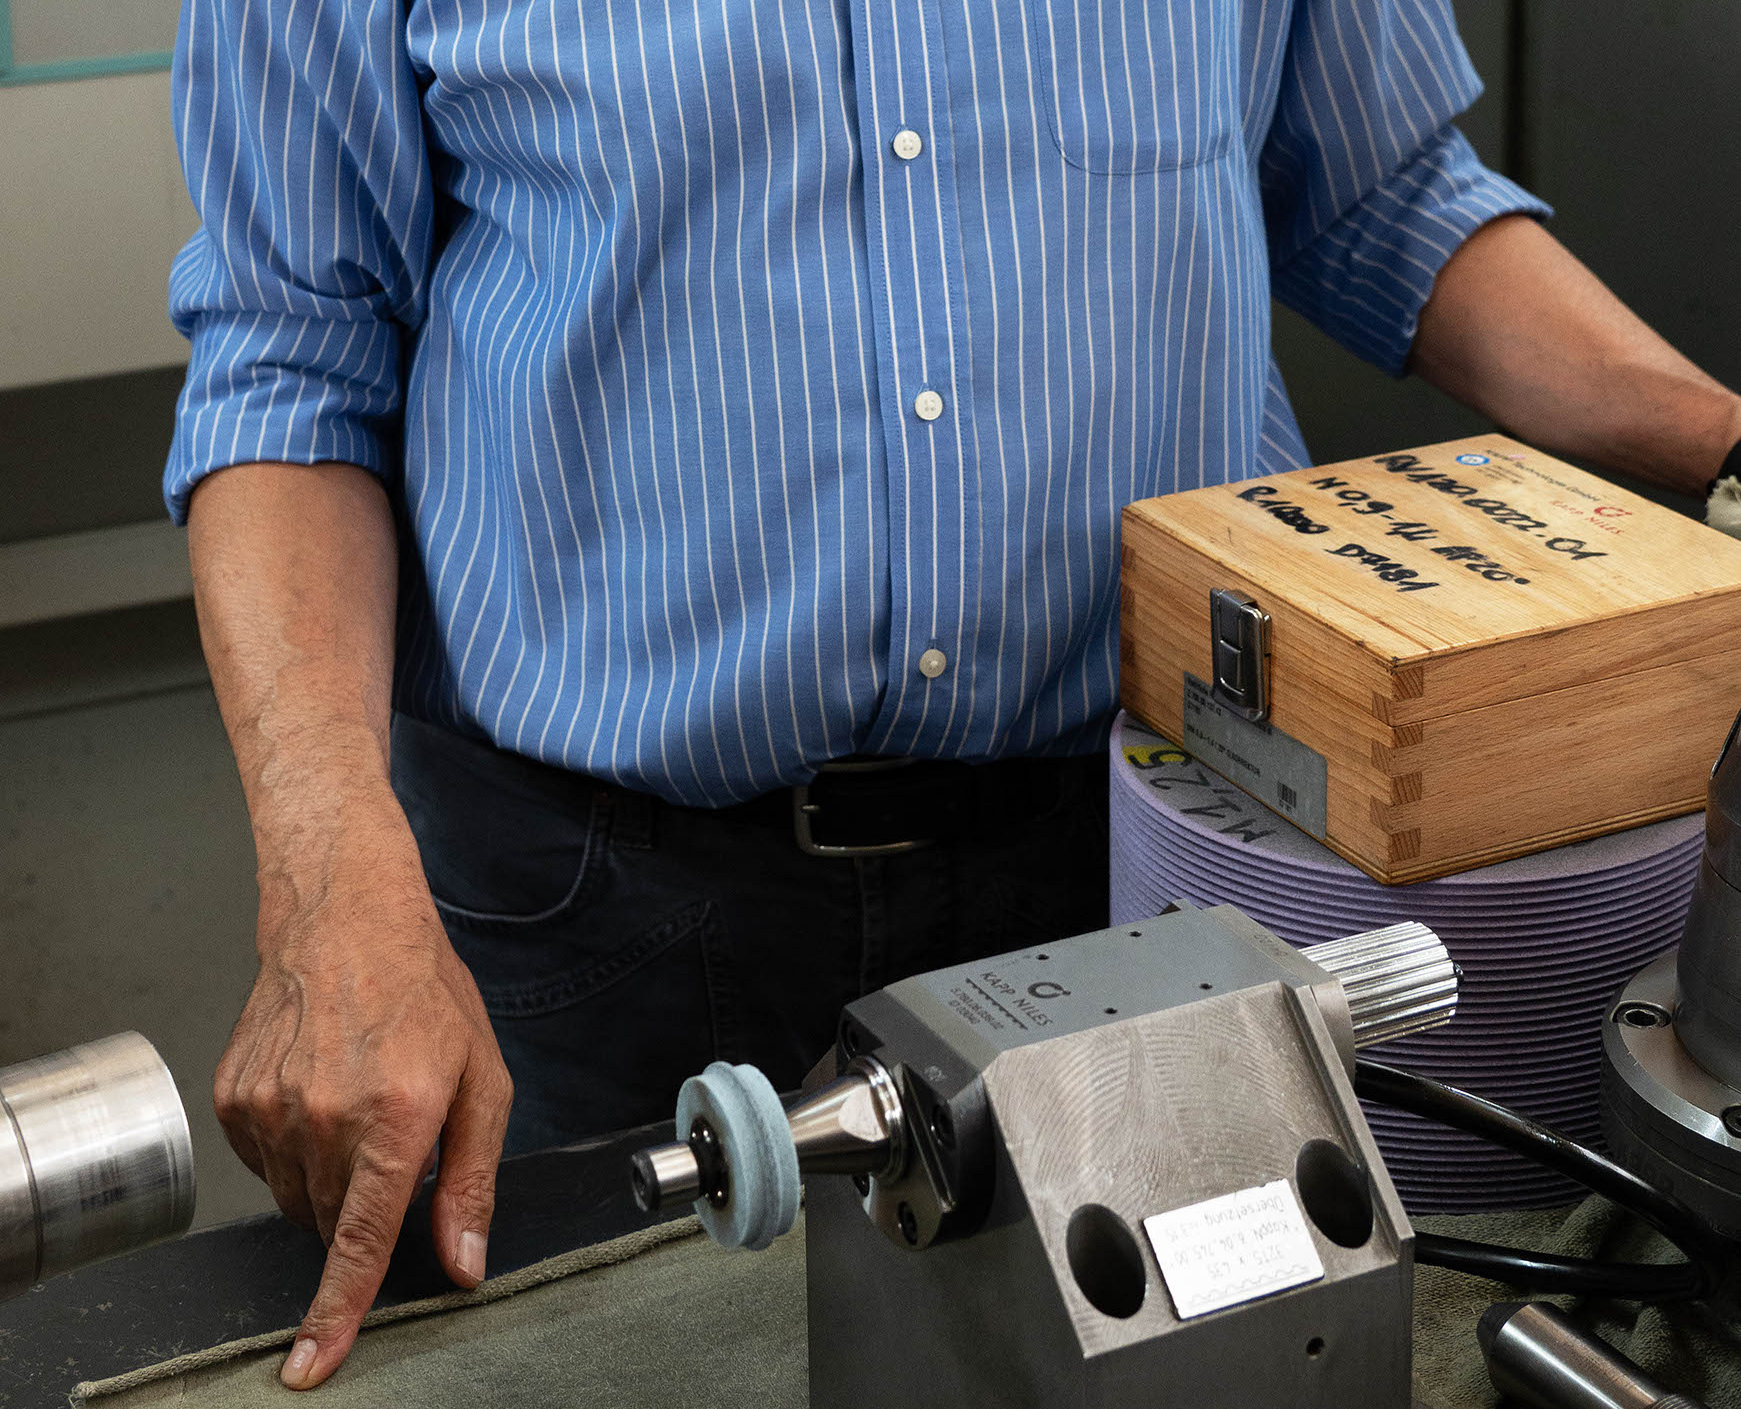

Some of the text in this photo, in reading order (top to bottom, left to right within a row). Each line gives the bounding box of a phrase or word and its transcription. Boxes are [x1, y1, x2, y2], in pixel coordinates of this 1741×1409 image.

[1585, 516, 1625, 536] NILES
[981, 972, 1016, 995] KAPP
[1012, 998, 1054, 1027] NILES
